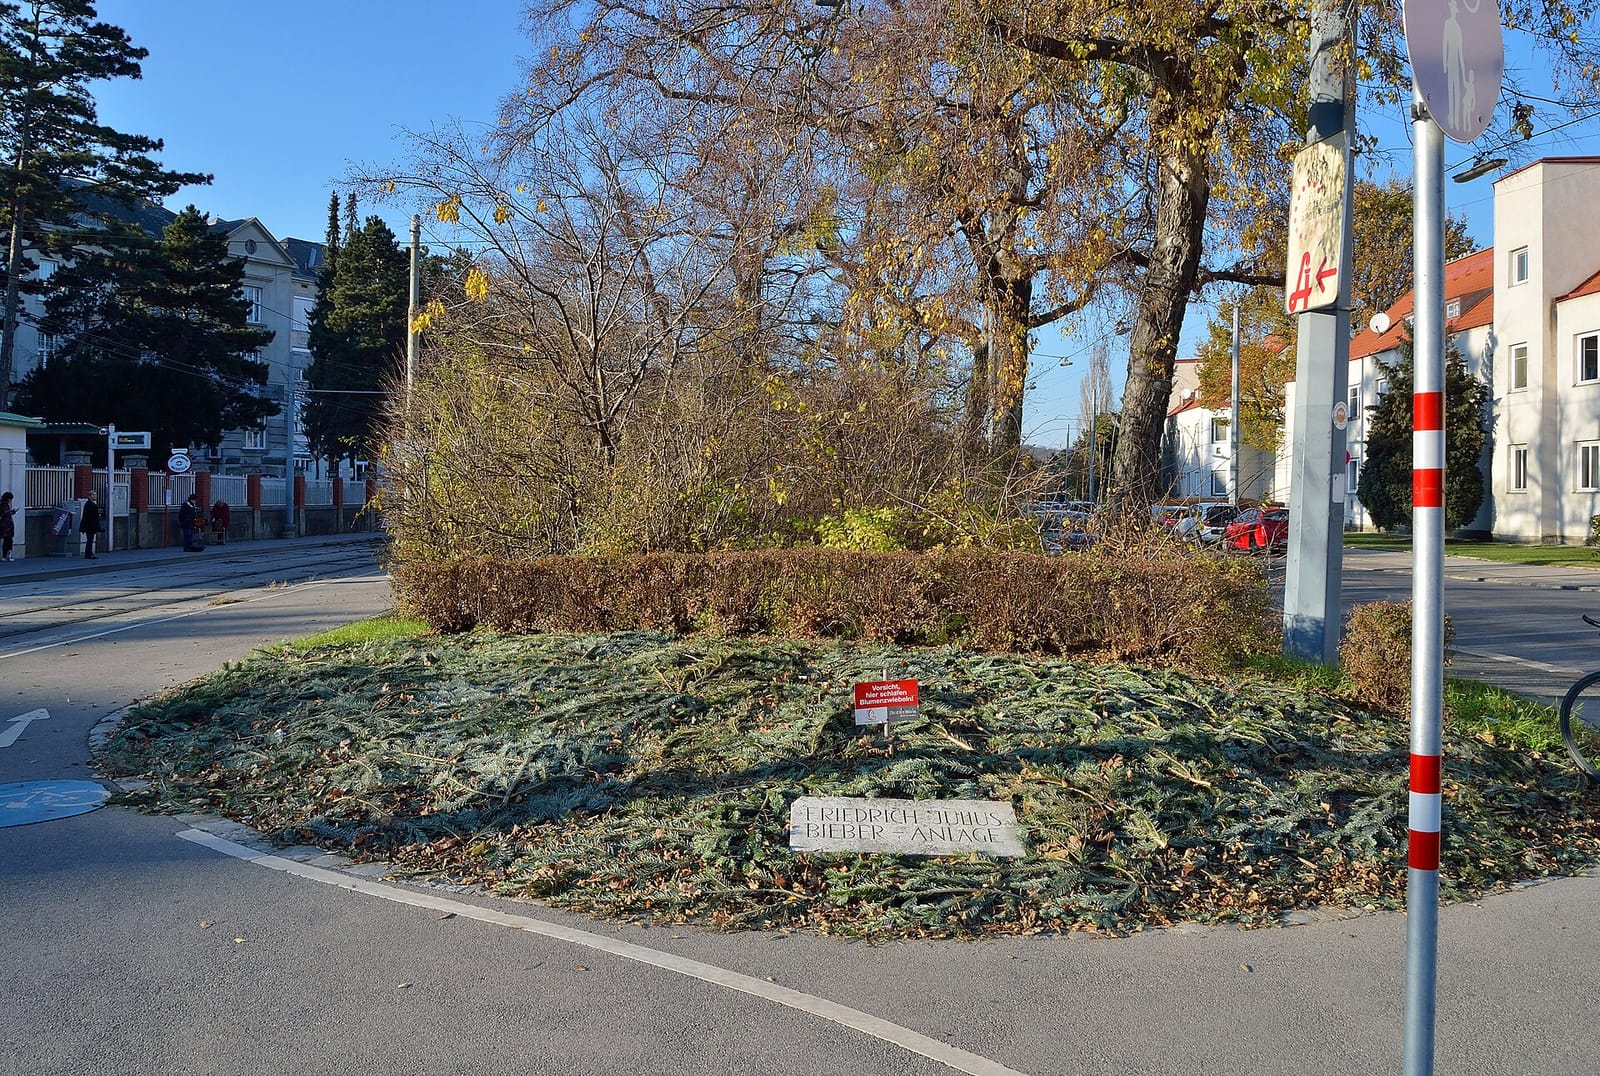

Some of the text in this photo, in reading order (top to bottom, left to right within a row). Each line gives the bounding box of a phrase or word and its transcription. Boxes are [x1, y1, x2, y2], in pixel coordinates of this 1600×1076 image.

[859, 696, 914, 705] Blumenzwiebeln!
[806, 806, 1003, 827] FRIEDRICH JULIUS
[806, 822, 885, 841] BIEBER
[910, 826, 1005, 844] ANLAGE
